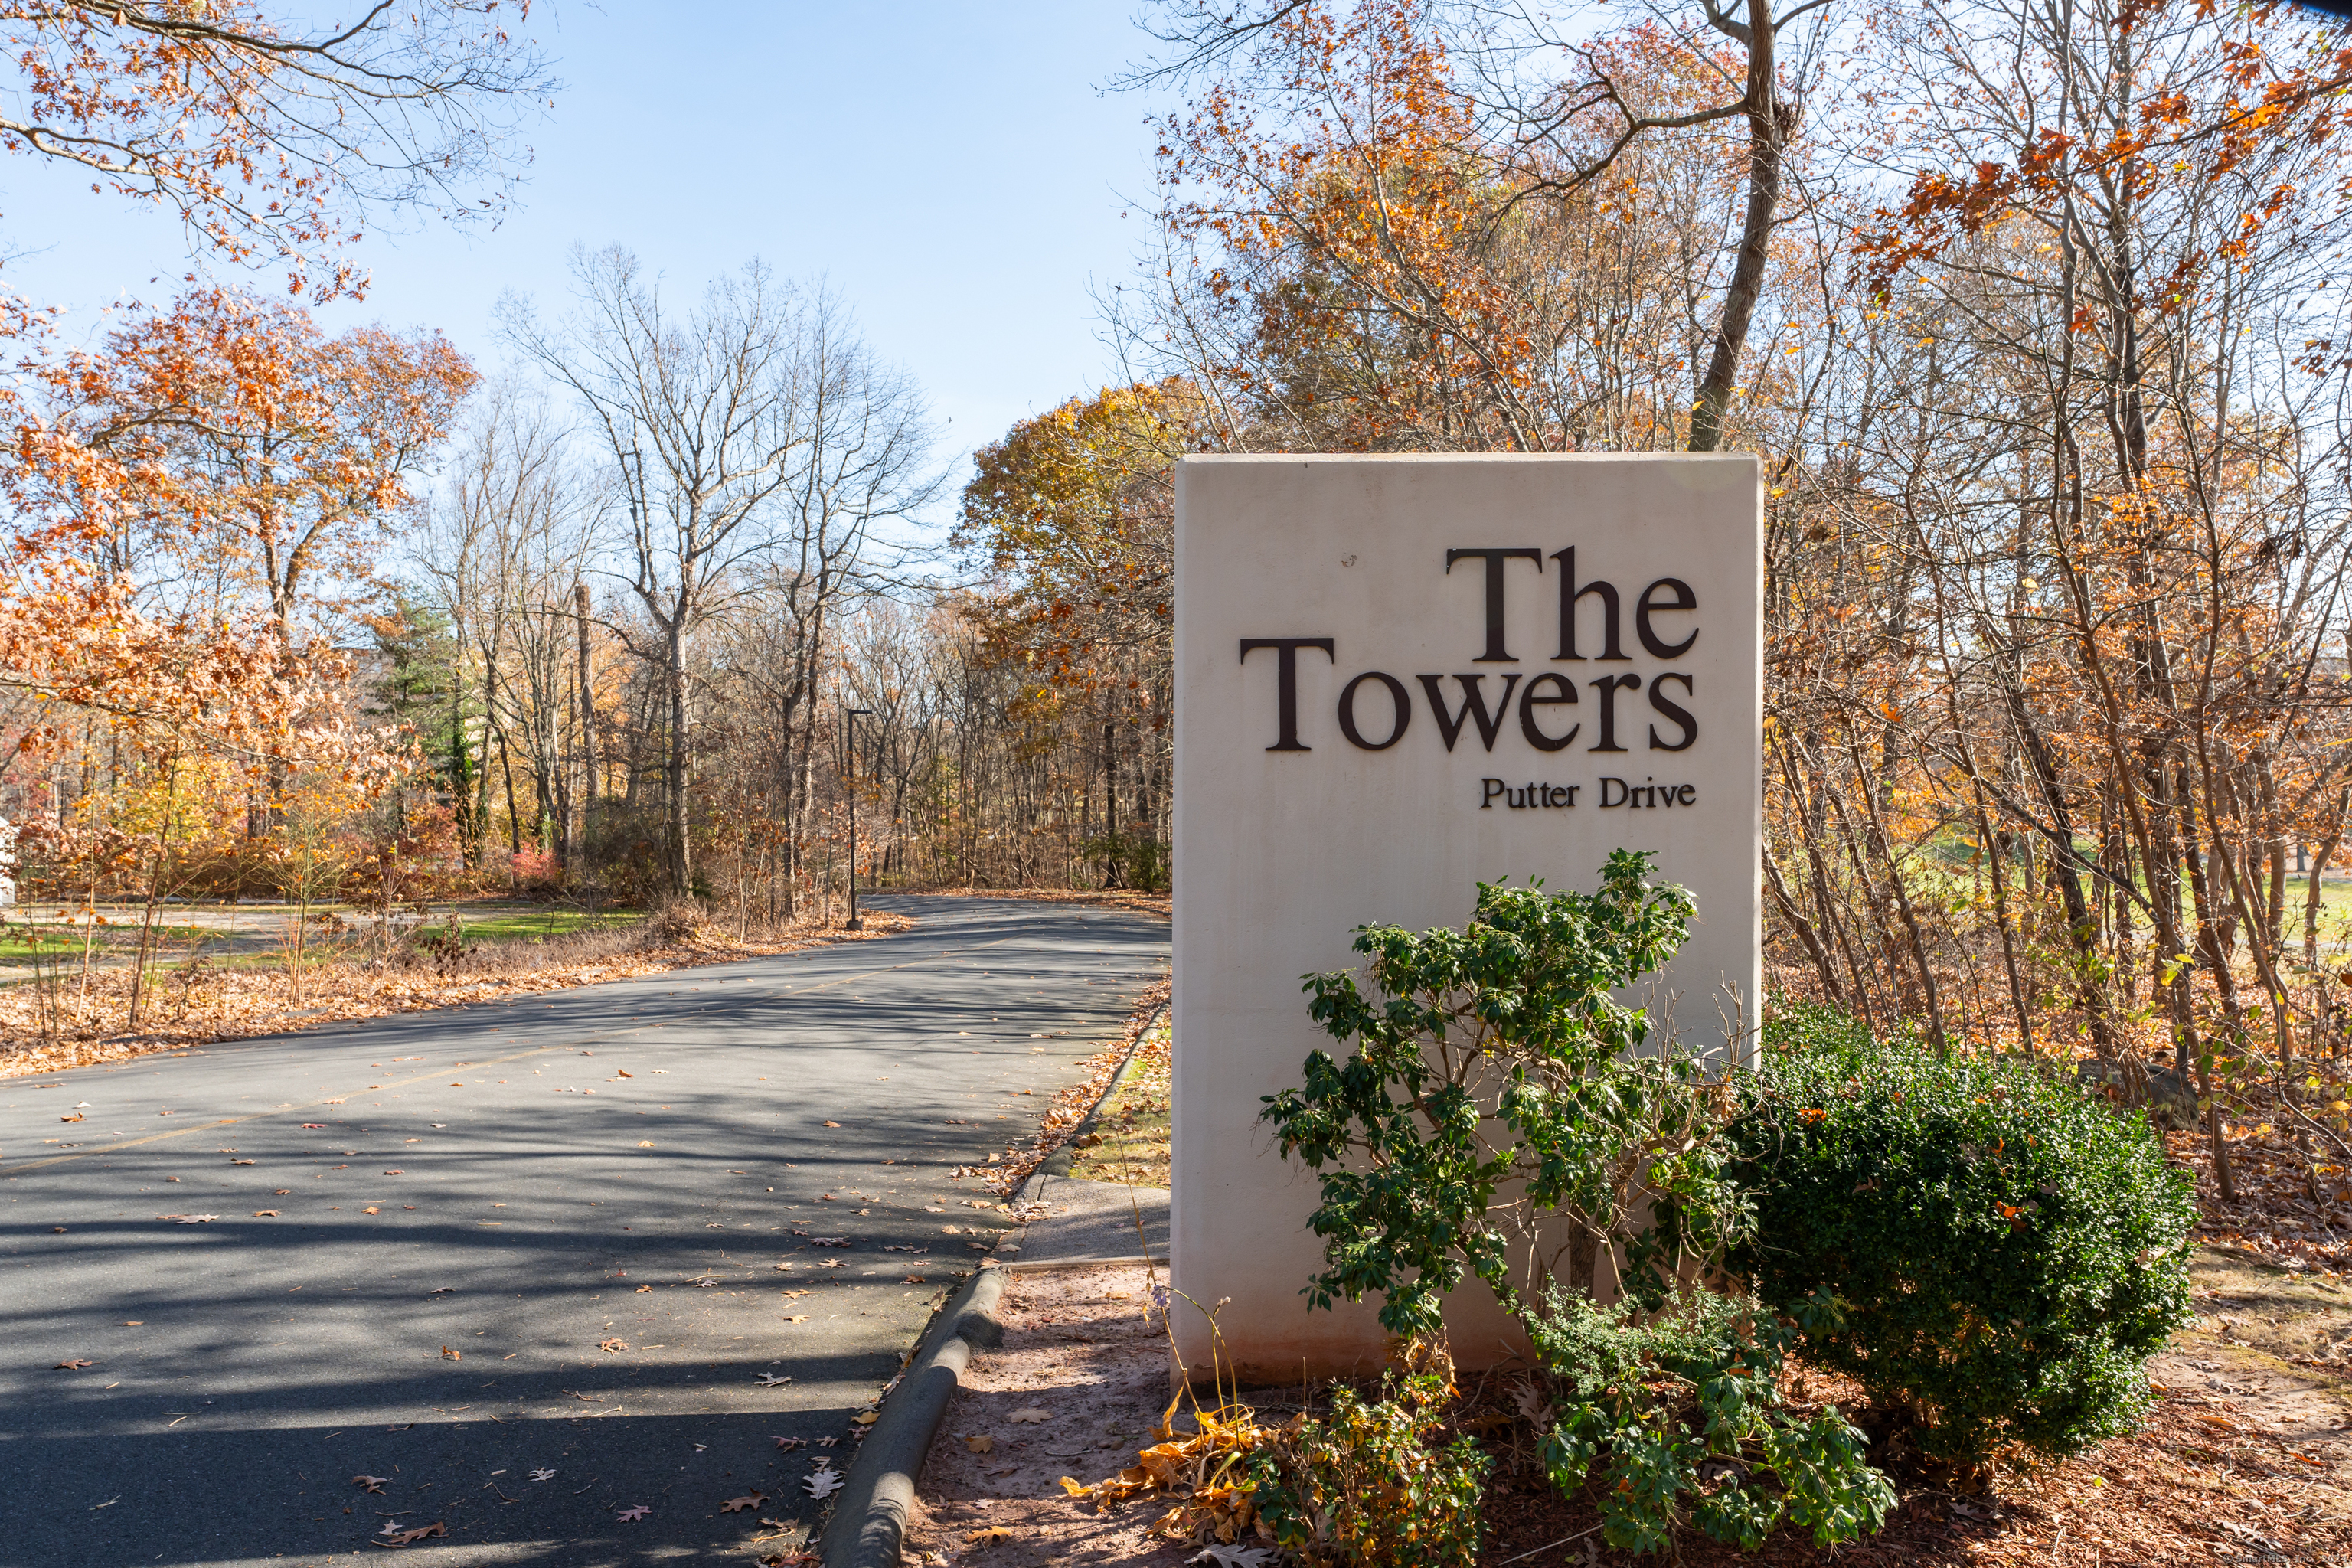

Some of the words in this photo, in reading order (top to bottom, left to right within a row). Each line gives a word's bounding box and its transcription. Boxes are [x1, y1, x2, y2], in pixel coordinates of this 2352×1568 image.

[1445, 545, 1700, 663] The
[1238, 636, 1700, 755] Towers
[1479, 778, 1581, 812] Putter
[1599, 776, 1697, 810] Drive
